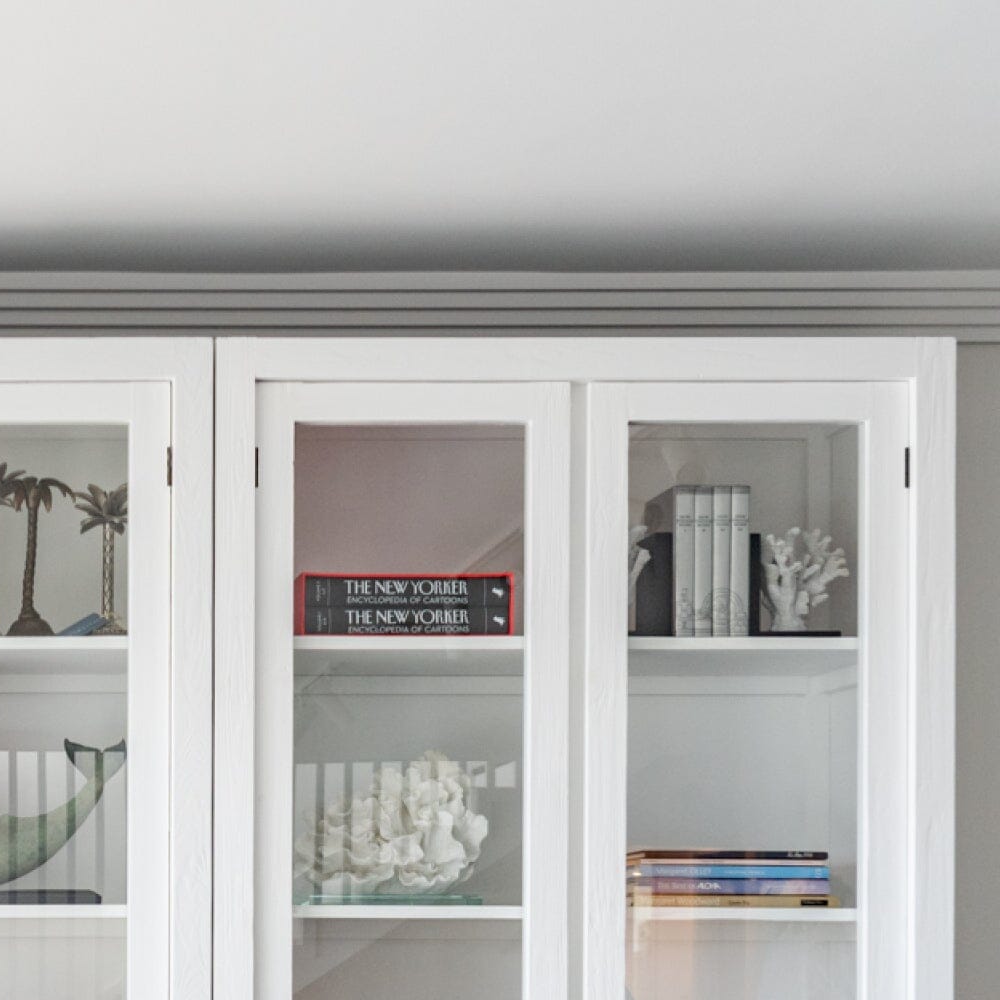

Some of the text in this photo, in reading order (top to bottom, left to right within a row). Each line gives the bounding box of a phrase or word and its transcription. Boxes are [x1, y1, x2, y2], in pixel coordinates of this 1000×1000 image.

[345, 580, 468, 595] THE NEW YORKER
[348, 596, 407, 604] ENCYCLOPEDIA
[345, 610, 468, 624] THE NEW YORKER
